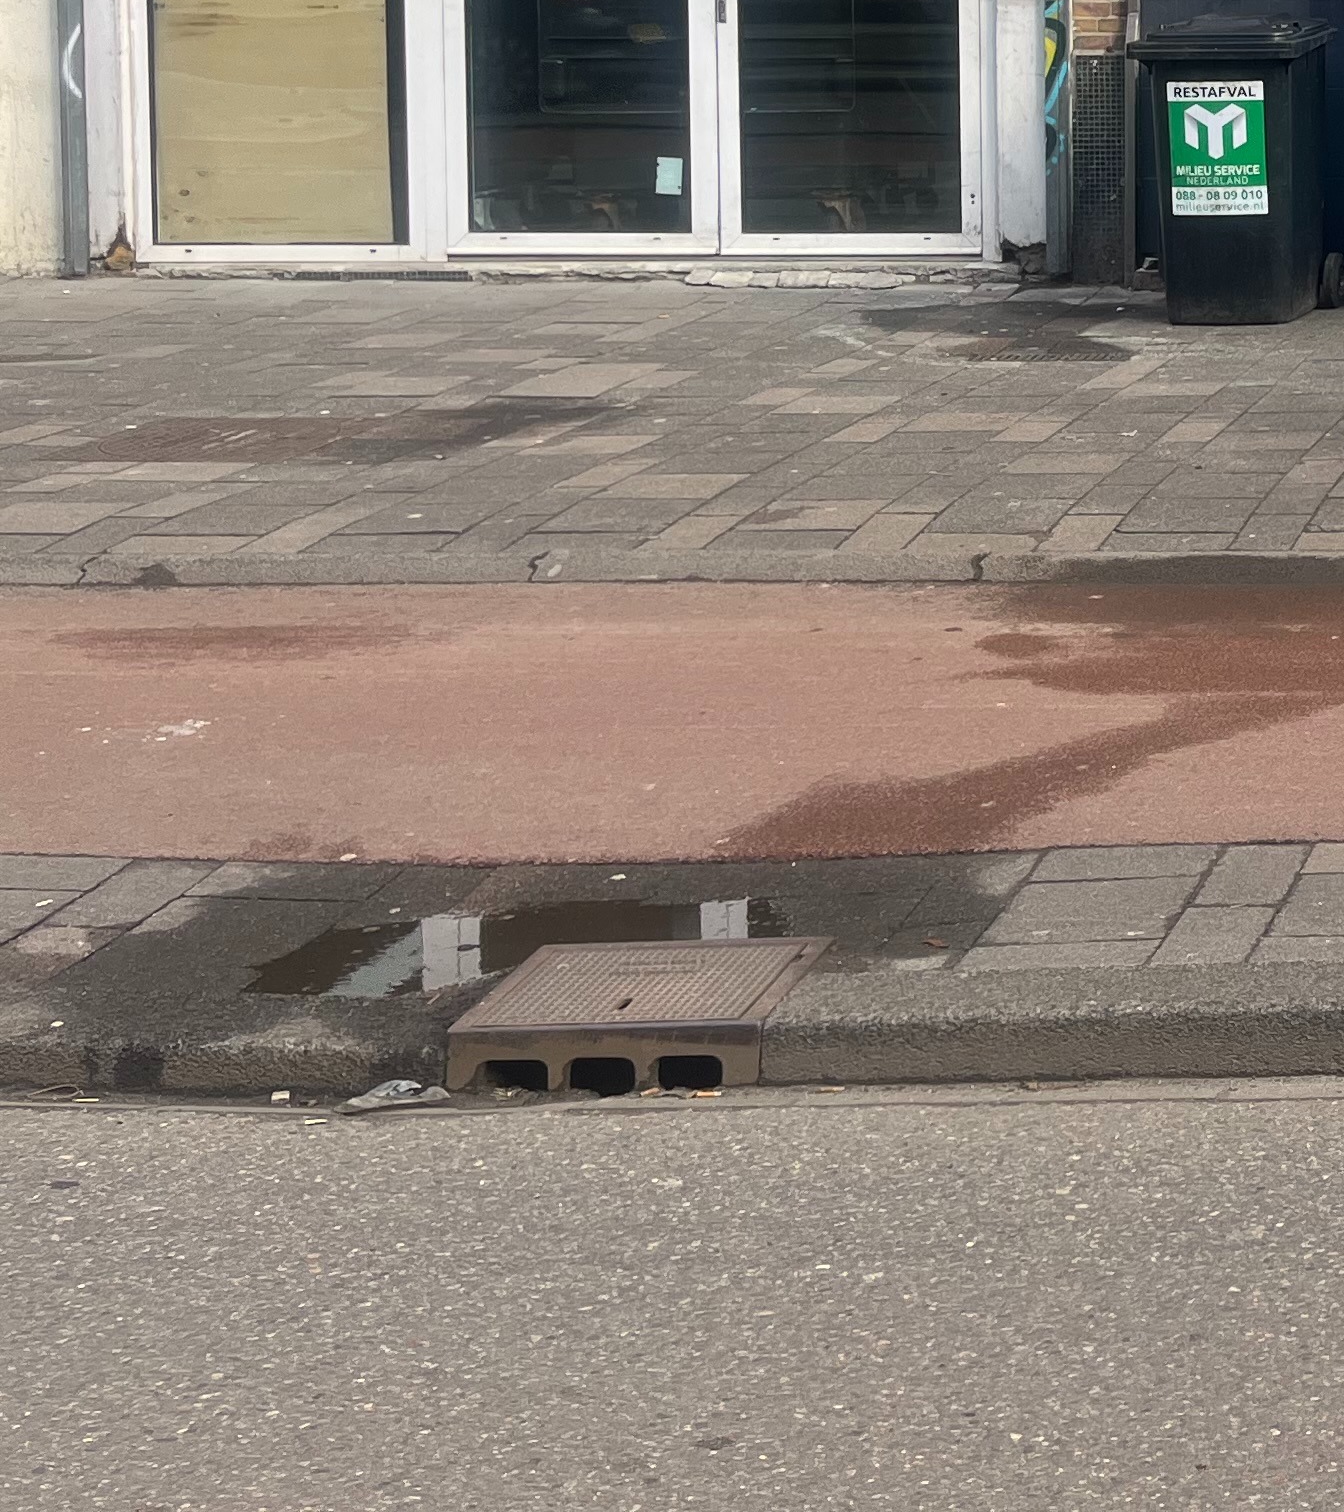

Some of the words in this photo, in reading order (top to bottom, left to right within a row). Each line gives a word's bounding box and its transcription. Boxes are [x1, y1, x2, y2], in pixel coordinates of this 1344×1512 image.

[1173, 86, 1256, 98] RESTAFVAL
[1176, 165, 1212, 176] MILIEU
[1215, 164, 1260, 176] SERVICE
[1186, 176, 1249, 186] NEDERLAND
[1176, 190, 1196, 200] 088
[1206, 190, 1220, 200] 08
[1223, 190, 1238, 200] 09
[1241, 189, 1263, 200] 010
[1175, 201, 1264, 213] milieuservice.nl
